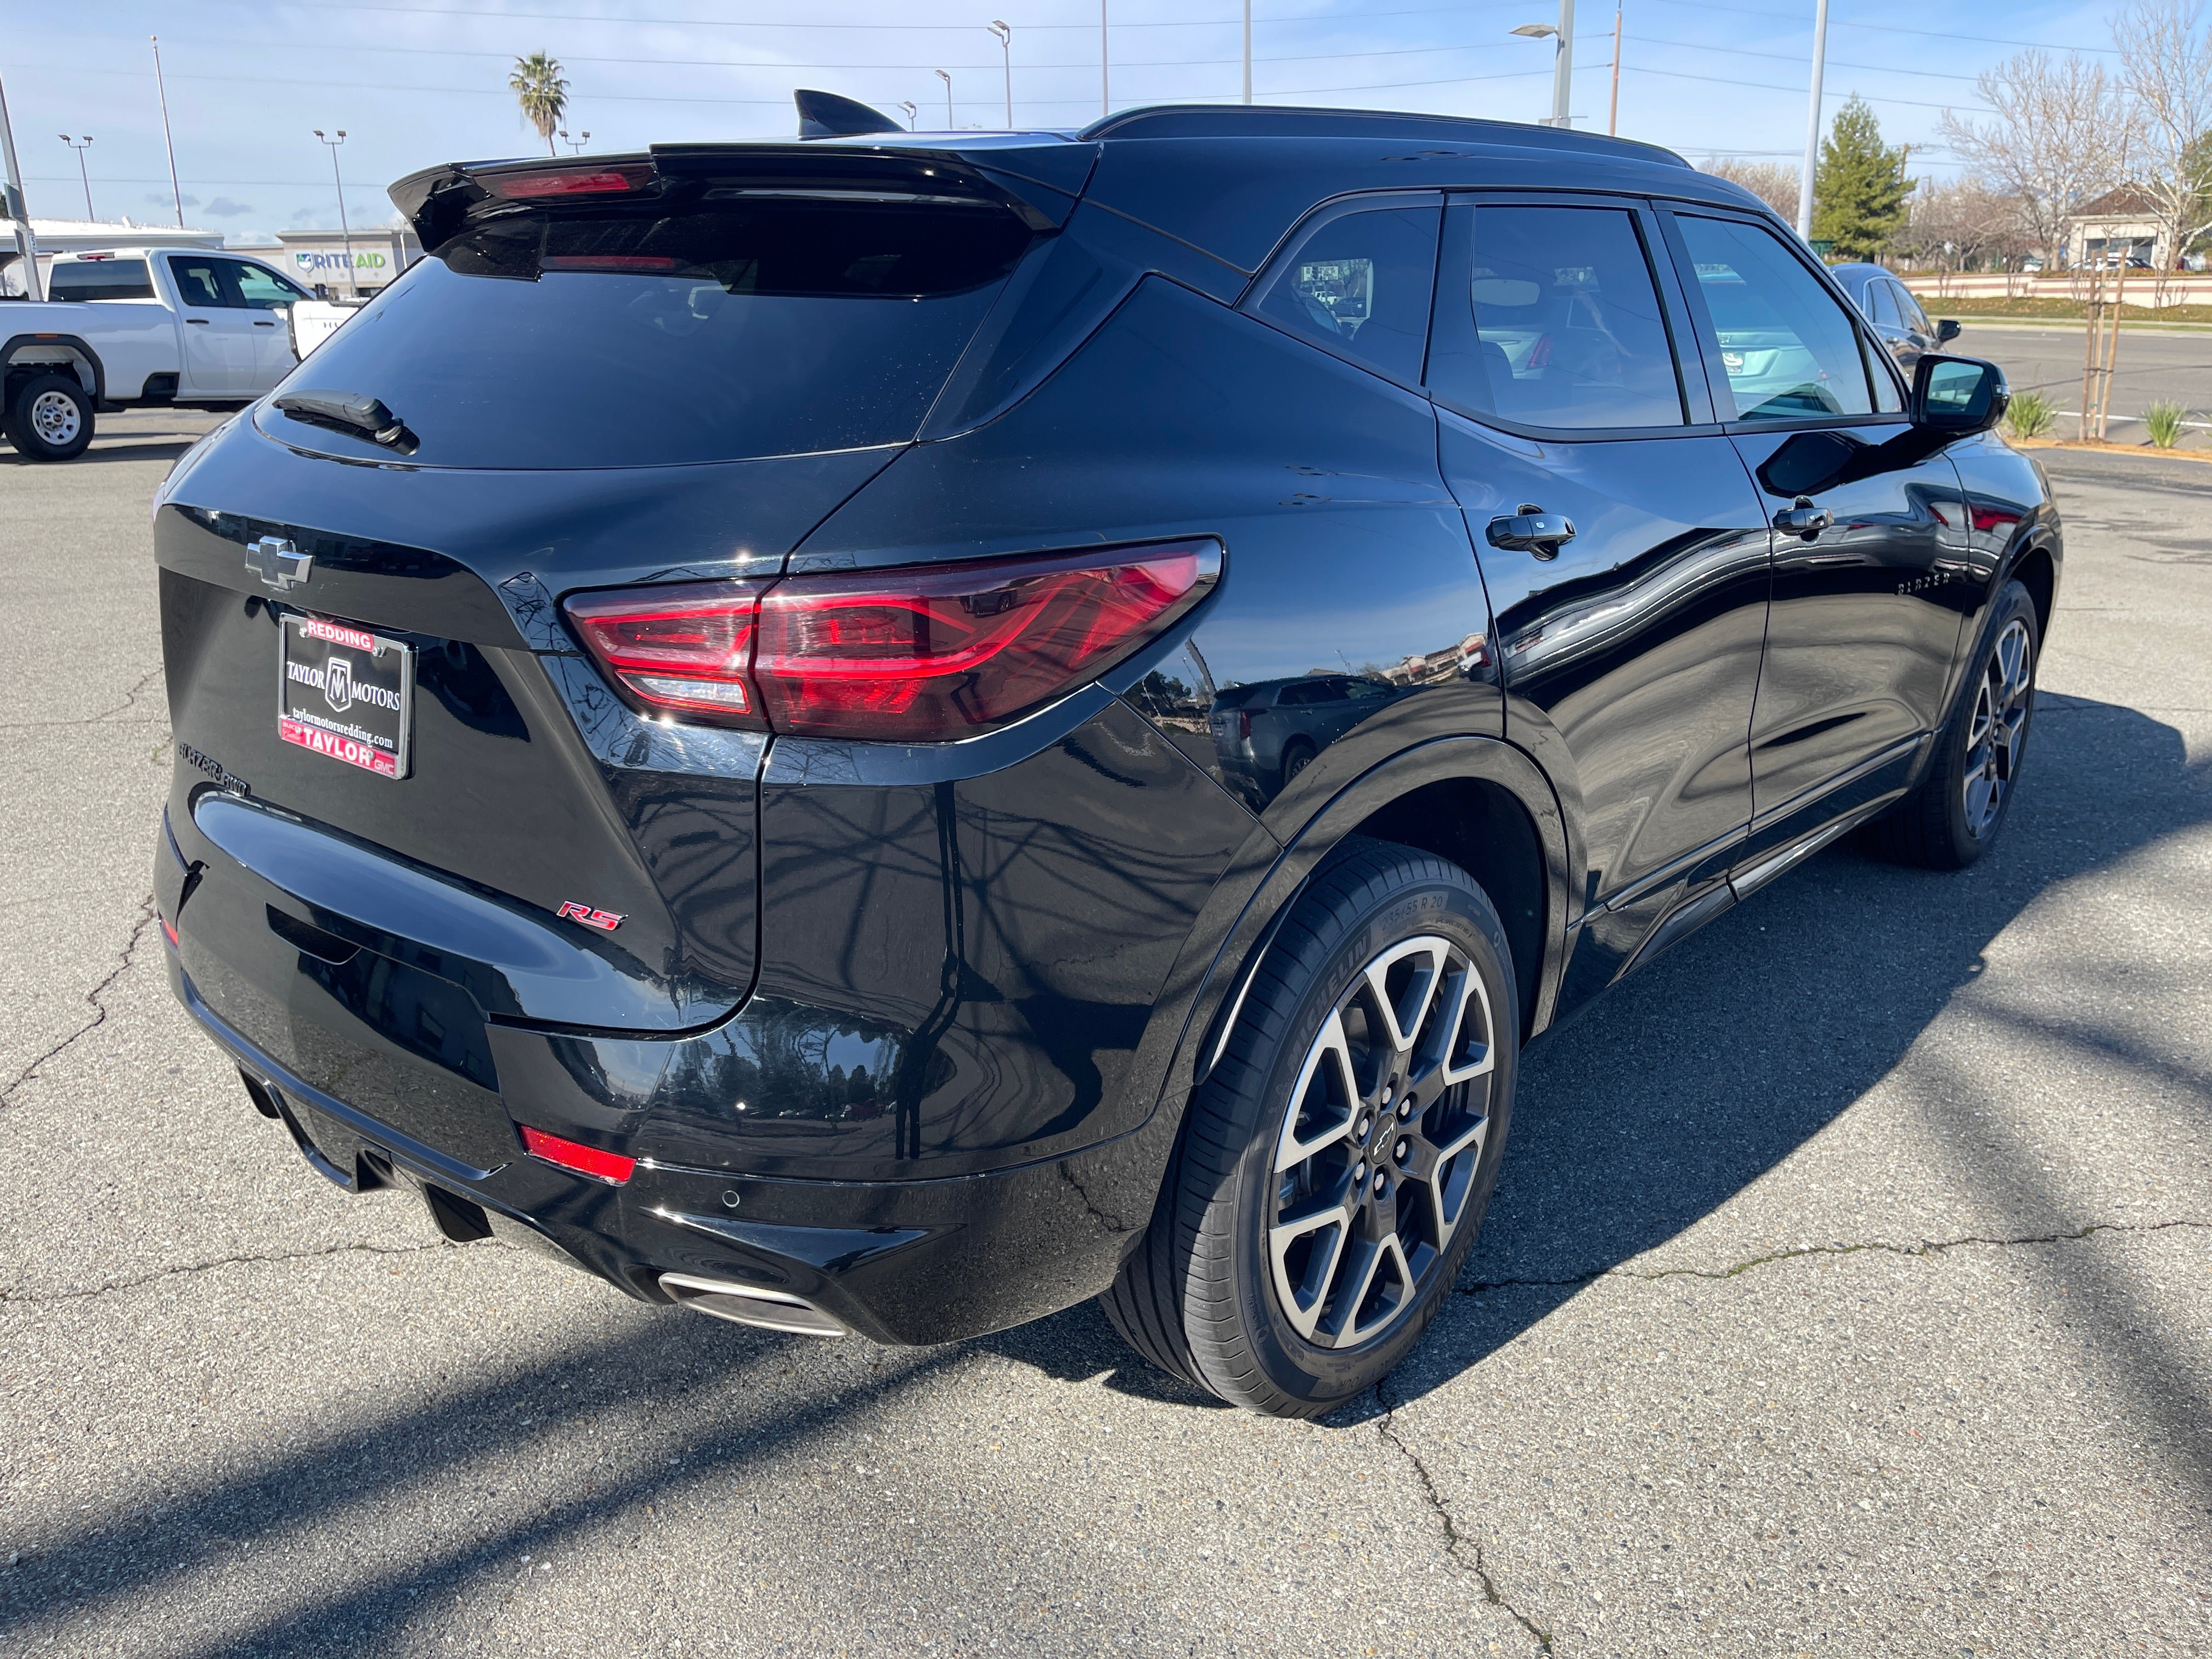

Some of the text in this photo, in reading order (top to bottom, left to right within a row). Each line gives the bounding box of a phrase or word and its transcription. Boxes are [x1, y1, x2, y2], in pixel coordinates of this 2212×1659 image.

[313, 253, 385, 268] RITE AID
[307, 620, 371, 649] REDDING
[287, 661, 400, 711] TAYLOR MOTORS
[292, 707, 393, 749] taylormotorsredding.com
[303, 728, 371, 766] TAYLOR
[374, 759, 394, 775] GMC
[556, 900, 622, 931] RS
[1382, 895, 1443, 931] 235/55 R 20
[1287, 935, 1368, 1074] MICHELIN
